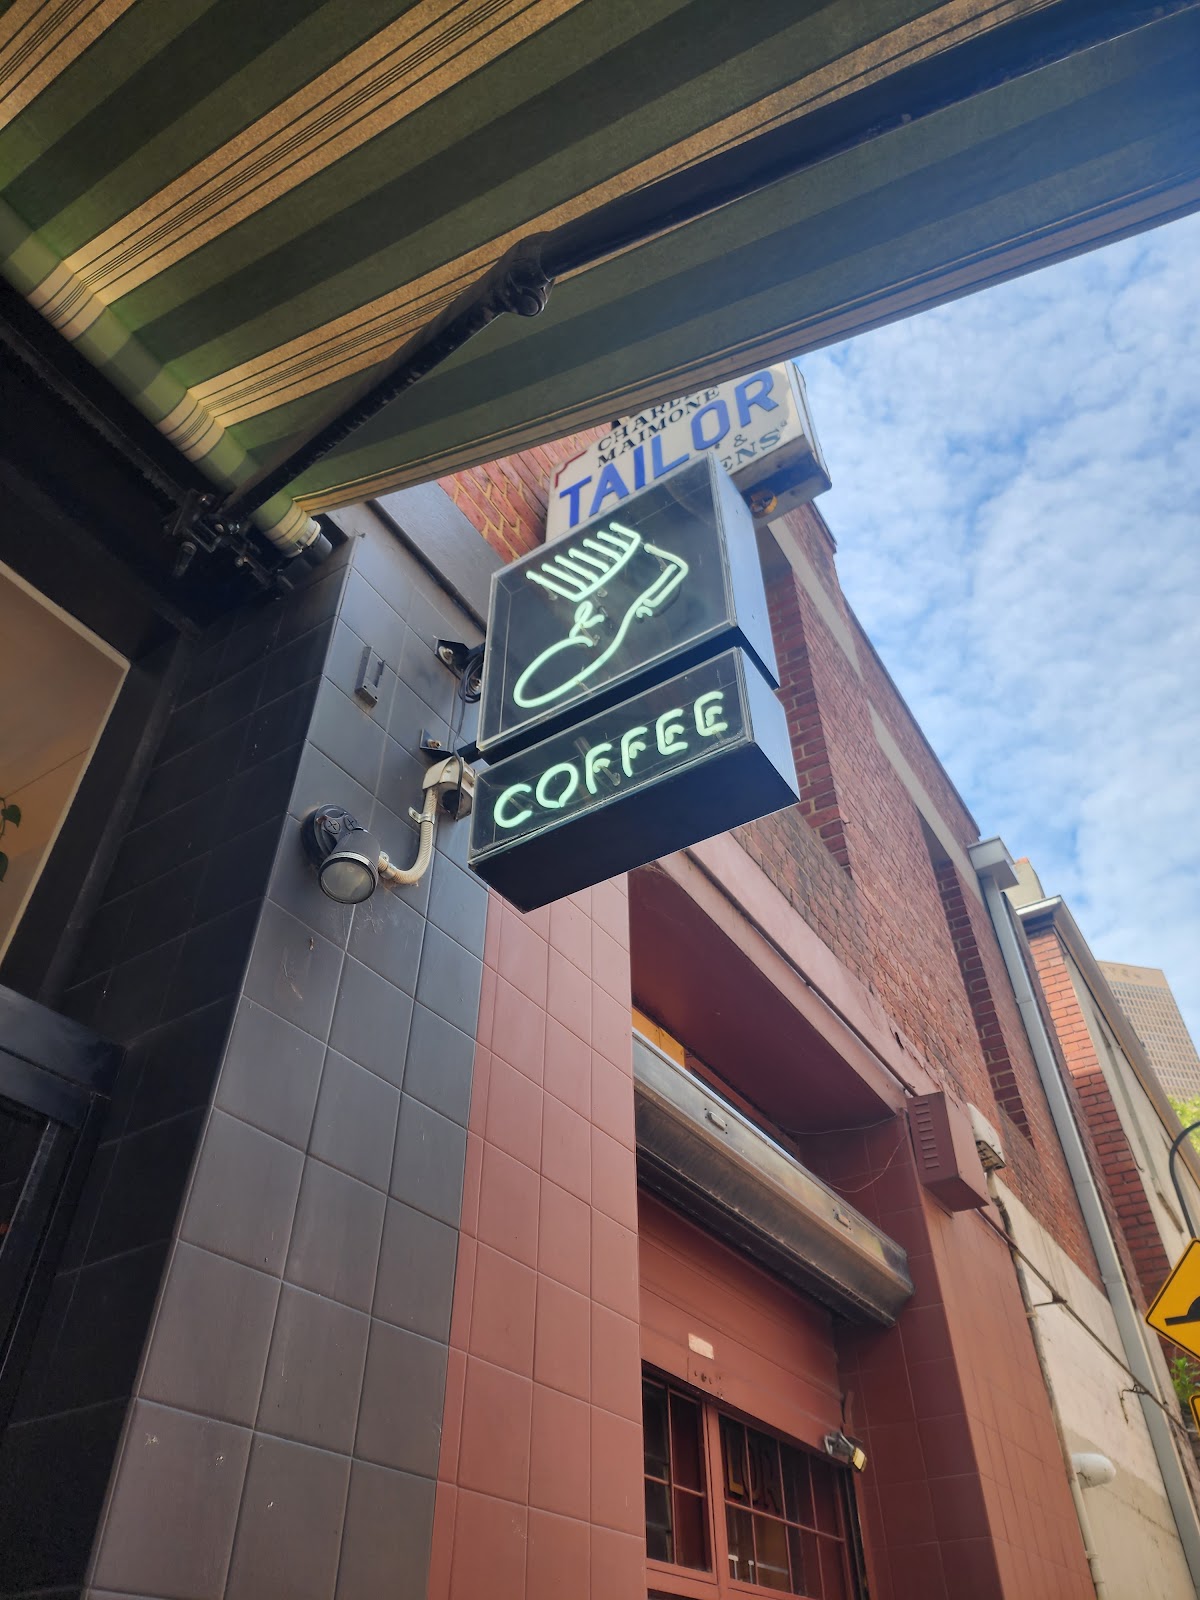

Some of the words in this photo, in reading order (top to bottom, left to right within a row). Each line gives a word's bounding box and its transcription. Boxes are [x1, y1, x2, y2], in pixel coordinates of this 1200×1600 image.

[559, 370, 779, 528] TAILOR
[598, 386, 720, 468] MAIMONE
[733, 434, 748, 448] &
[493, 691, 728, 828] COFFEE
